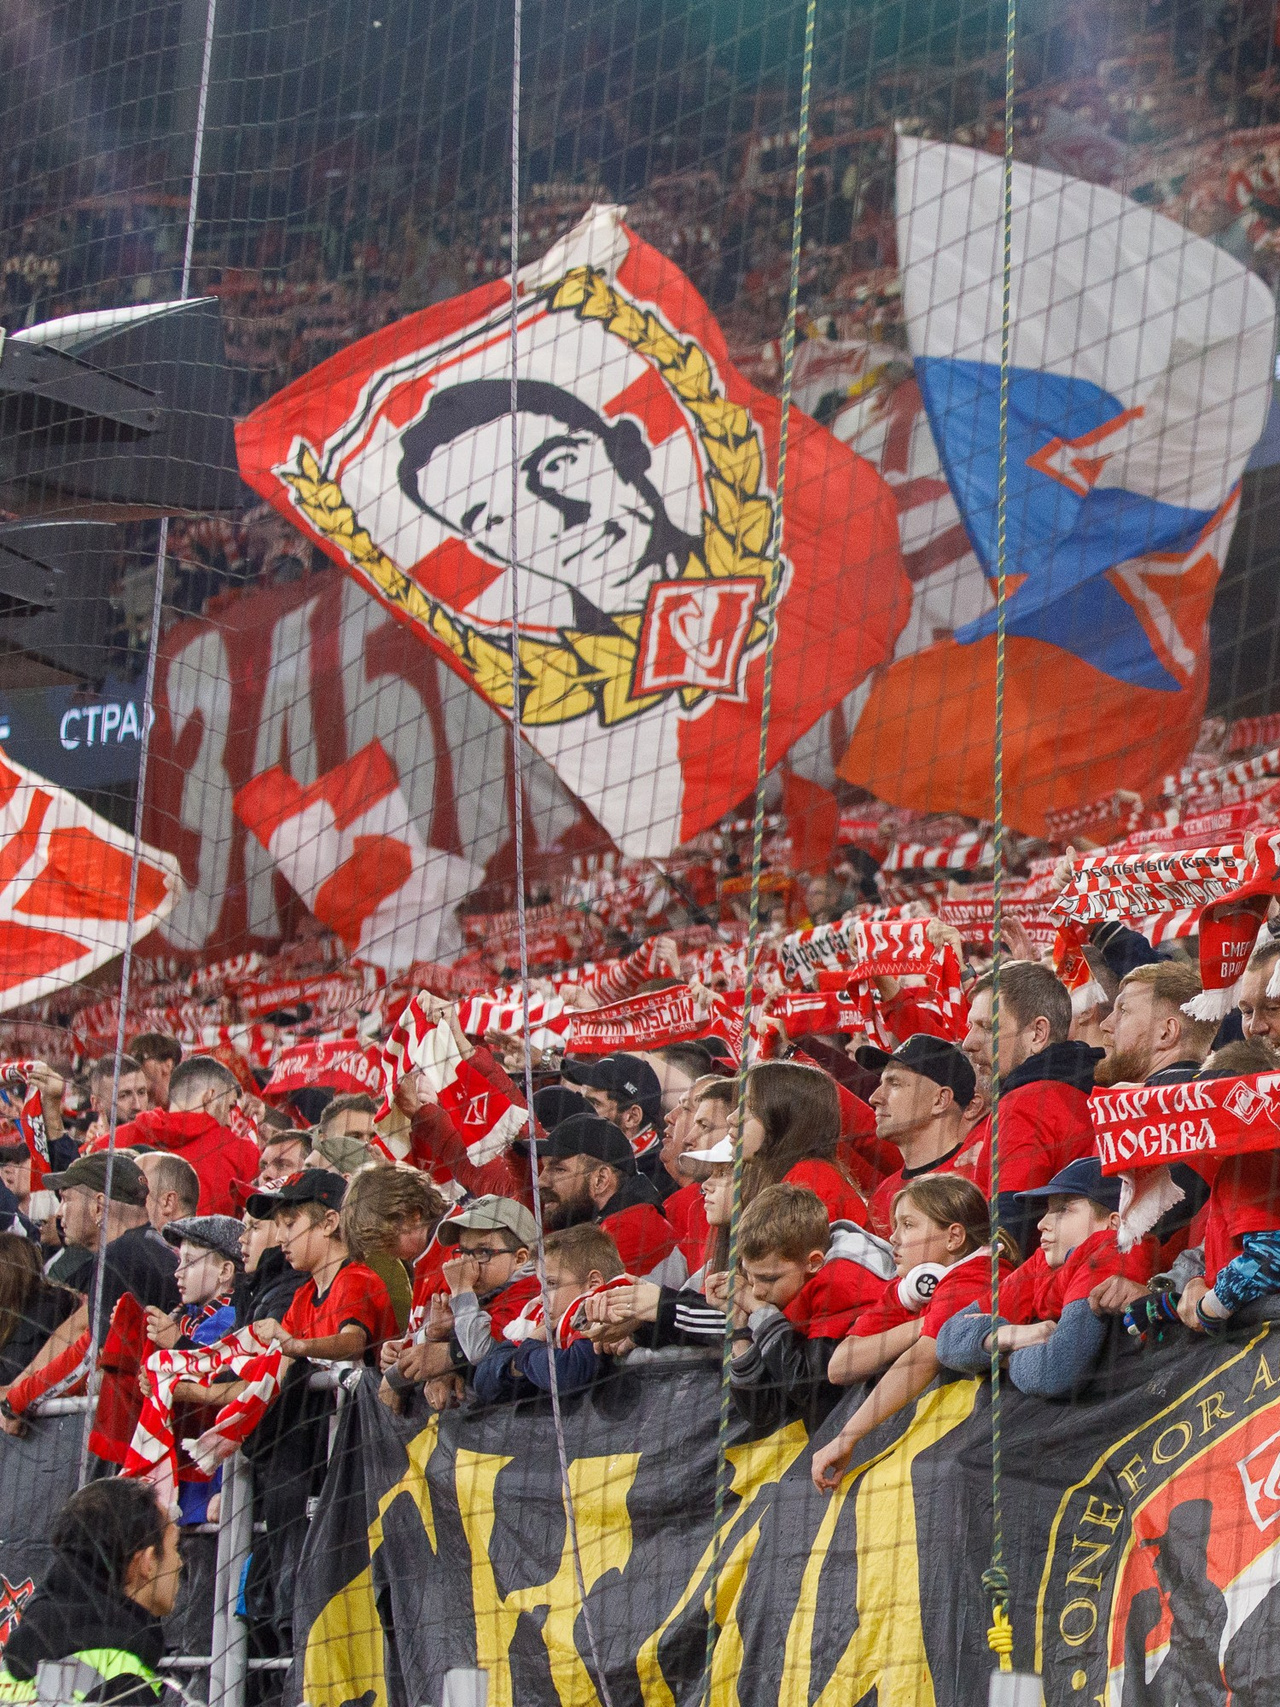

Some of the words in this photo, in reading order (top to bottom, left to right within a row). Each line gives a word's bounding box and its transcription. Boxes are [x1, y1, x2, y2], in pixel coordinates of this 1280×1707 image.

[1074, 859, 1176, 883] УТБОЛЬНЫЙ
[1181, 855, 1237, 870] КЛУБ
[781, 926, 850, 981] Sparta
[630, 997, 694, 1036] MOSCOW
[1059, 1494, 1124, 1646] ONE
[1117, 1390, 1236, 1501] FOR
